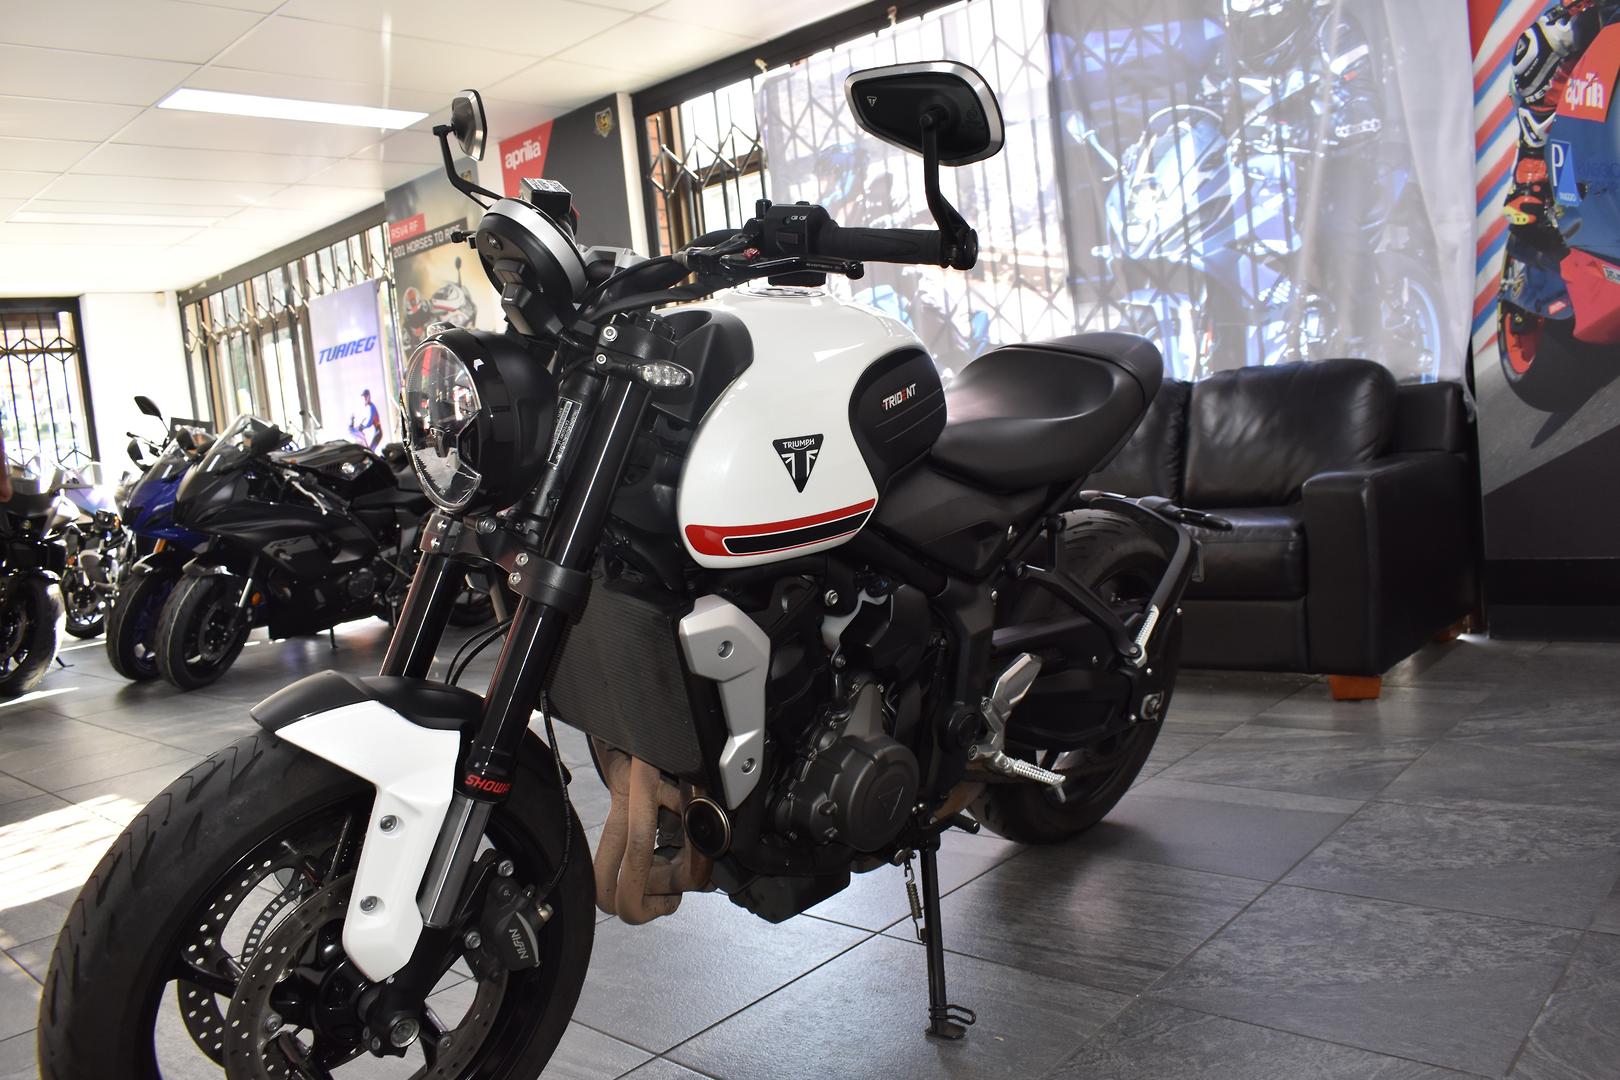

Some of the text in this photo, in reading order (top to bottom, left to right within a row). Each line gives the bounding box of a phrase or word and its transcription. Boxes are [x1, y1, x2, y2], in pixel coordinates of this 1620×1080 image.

[504, 140, 542, 170] aprilia
[393, 245, 406, 258] 201
[406, 234, 434, 253] HORSES
[434, 230, 444, 245] TO
[882, 383, 917, 411] TRIDENT
[782, 438, 815, 450] TRIUMPH
